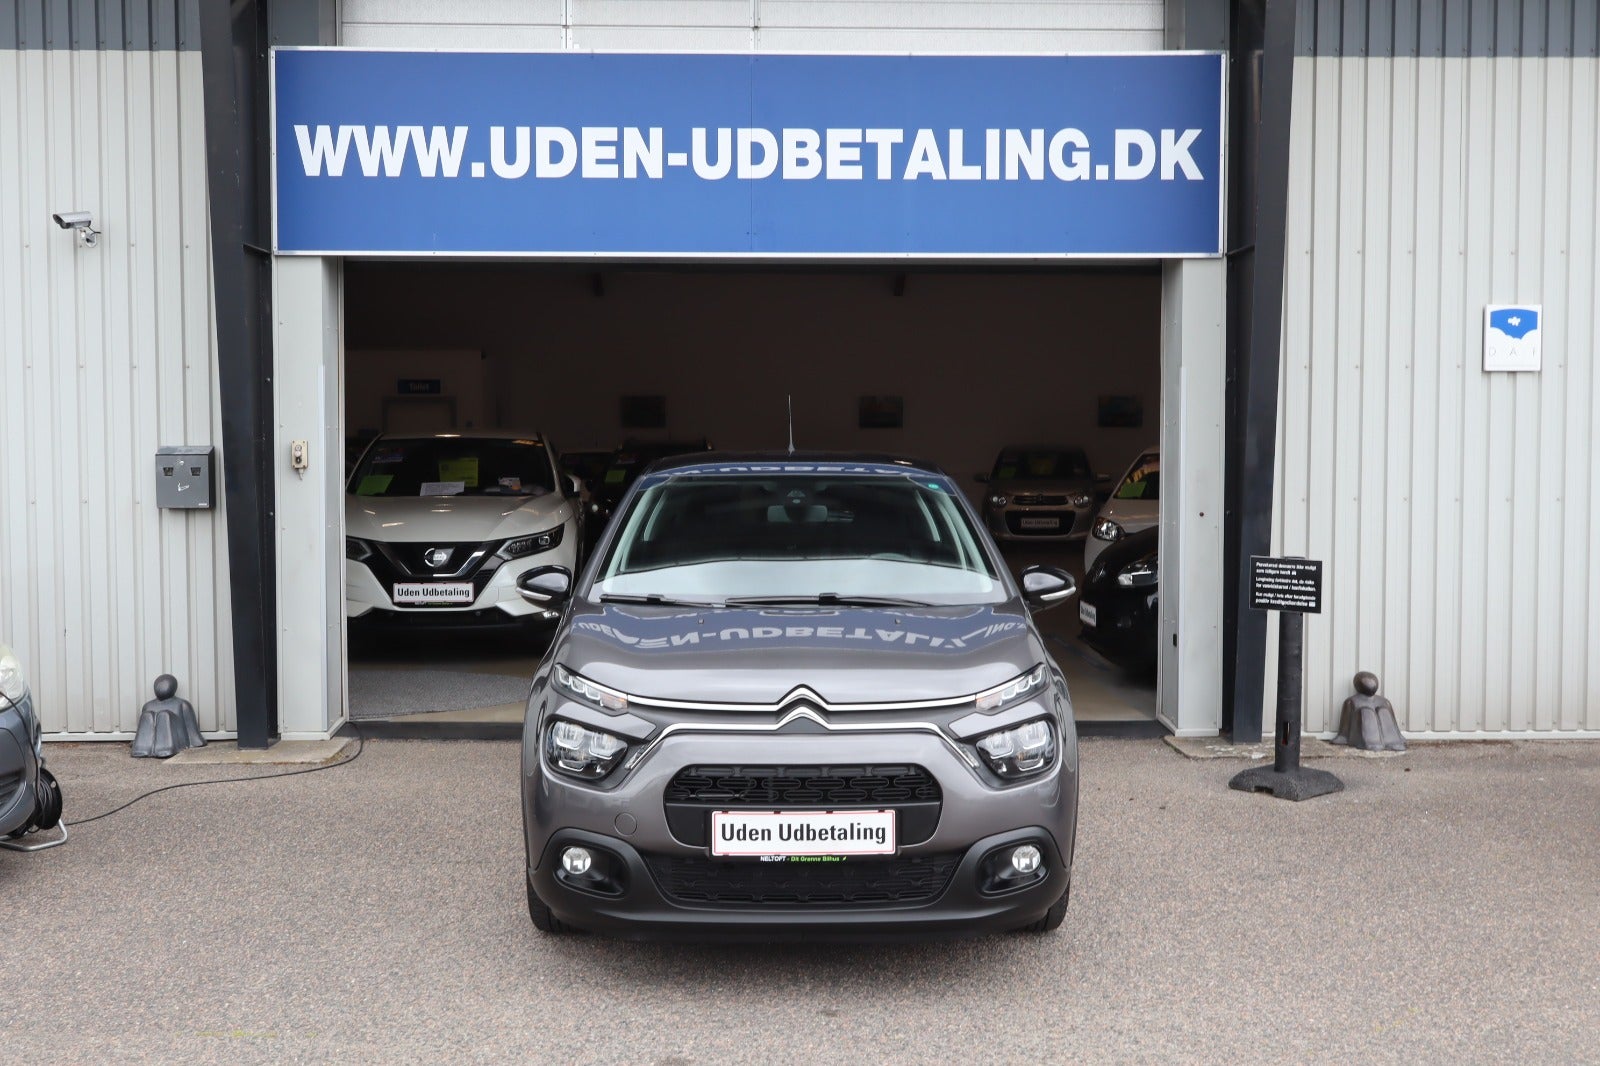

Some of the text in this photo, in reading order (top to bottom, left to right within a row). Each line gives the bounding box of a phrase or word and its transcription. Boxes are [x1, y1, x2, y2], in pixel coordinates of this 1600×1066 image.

[294, 124, 1204, 182] WWW.UDEN-UDBETALING.DK
[397, 587, 470, 598] Uden Udbetaling
[721, 822, 886, 845] Uden Udbetaling
